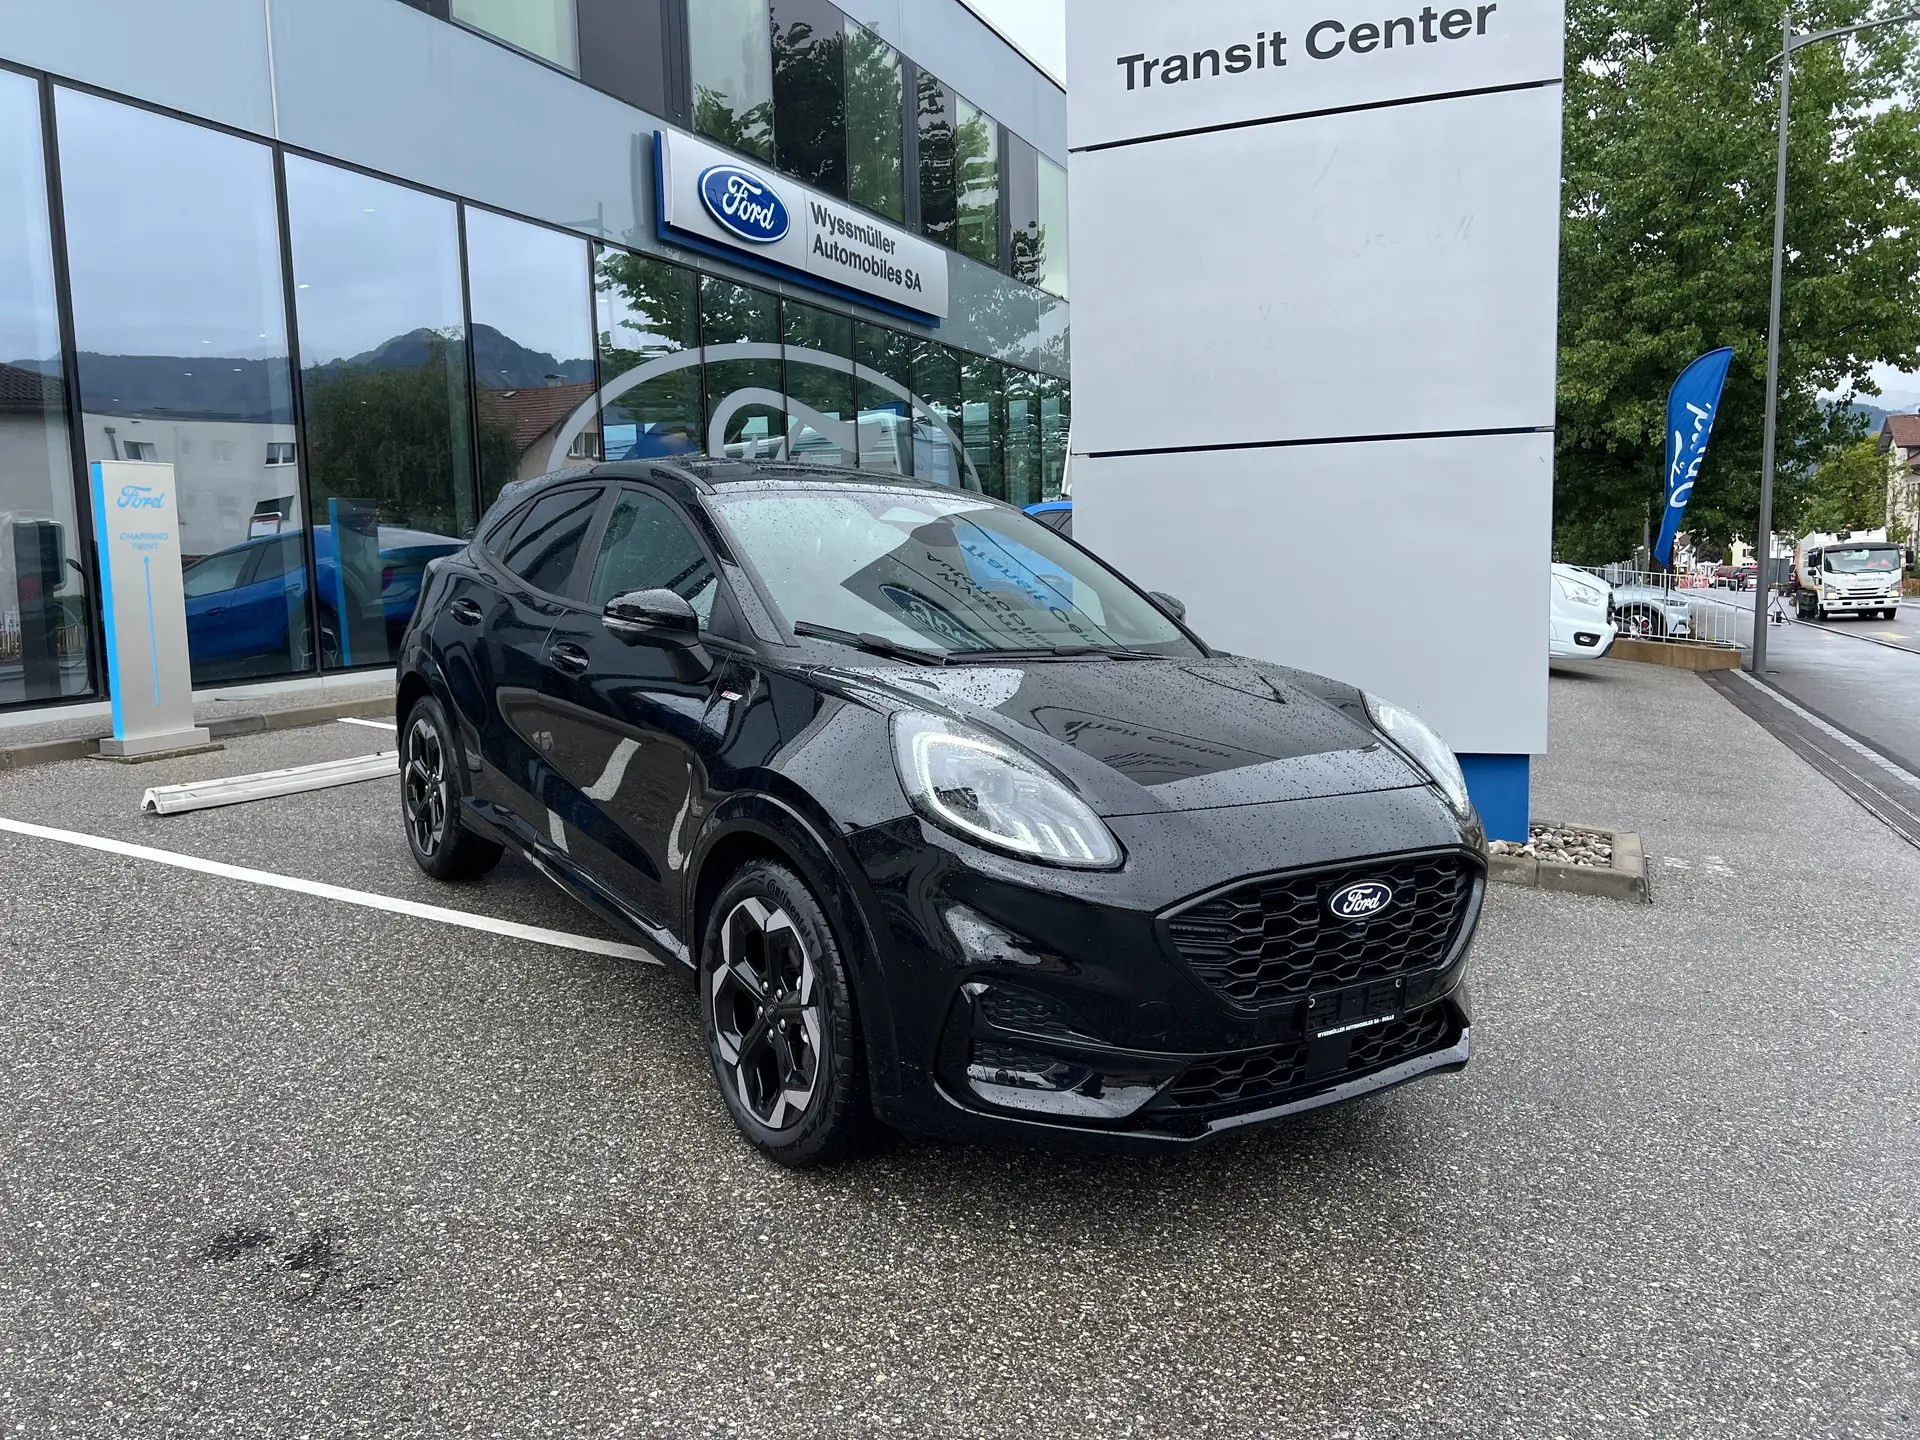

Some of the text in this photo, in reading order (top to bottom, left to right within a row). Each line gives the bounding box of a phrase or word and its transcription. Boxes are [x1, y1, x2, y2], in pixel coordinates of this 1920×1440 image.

[1117, 3, 1497, 91] Transit Center
[722, 175, 775, 230] Ford
[810, 201, 896, 255] Wyssmüller
[813, 234, 922, 292] Automobiles SA
[117, 486, 164, 508] Ford
[120, 532, 169, 540] CHARGING
[1343, 888, 1382, 913] Ford
